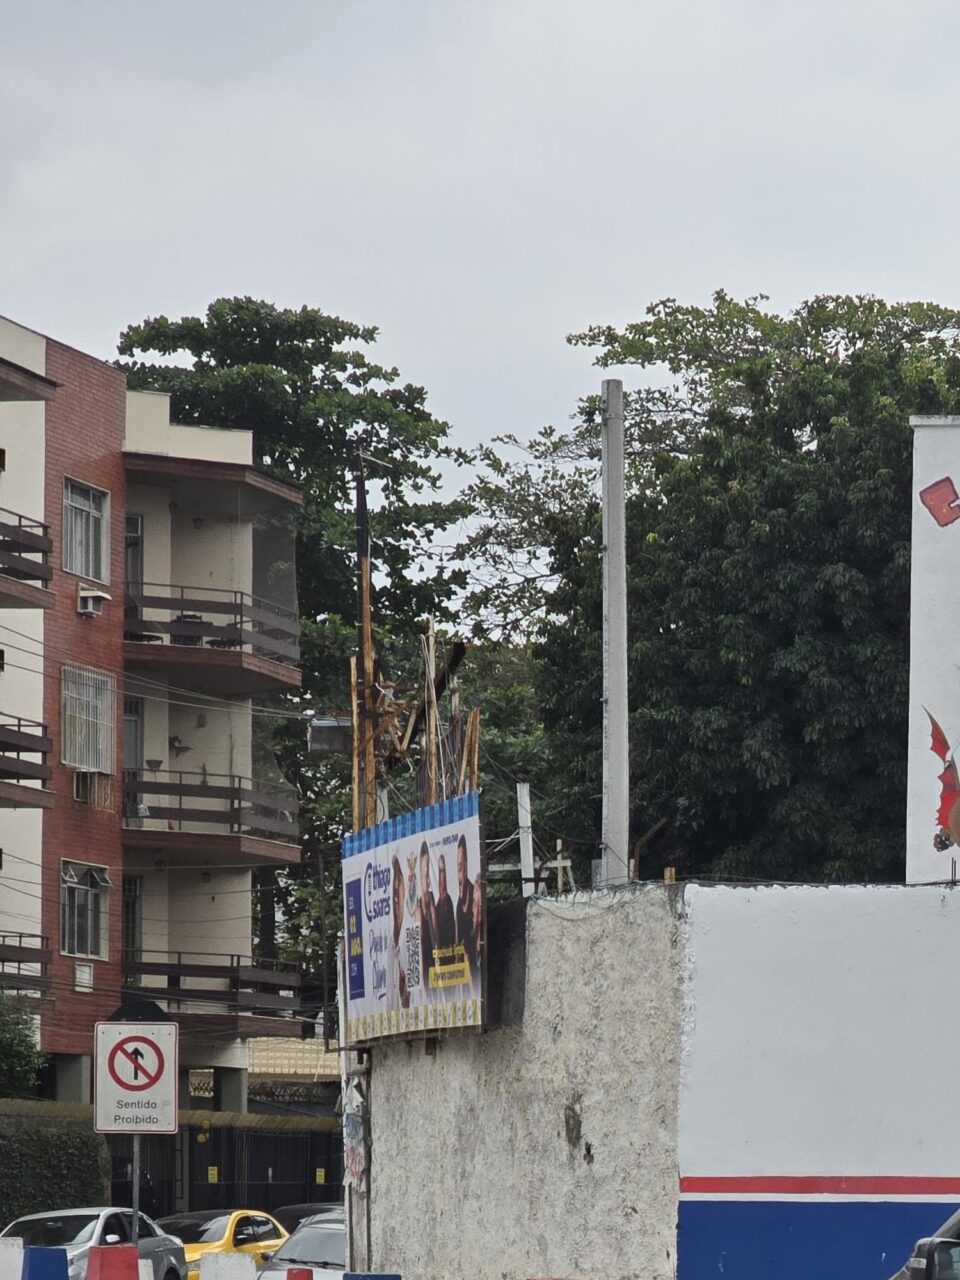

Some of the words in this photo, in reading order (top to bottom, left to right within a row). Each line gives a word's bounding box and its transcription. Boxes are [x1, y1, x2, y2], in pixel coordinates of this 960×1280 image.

[372, 862, 391, 895] thiago
[372, 895, 391, 921] soares
[116, 1100, 157, 1109] Sentido
[113, 1115, 159, 1124] Proibido
